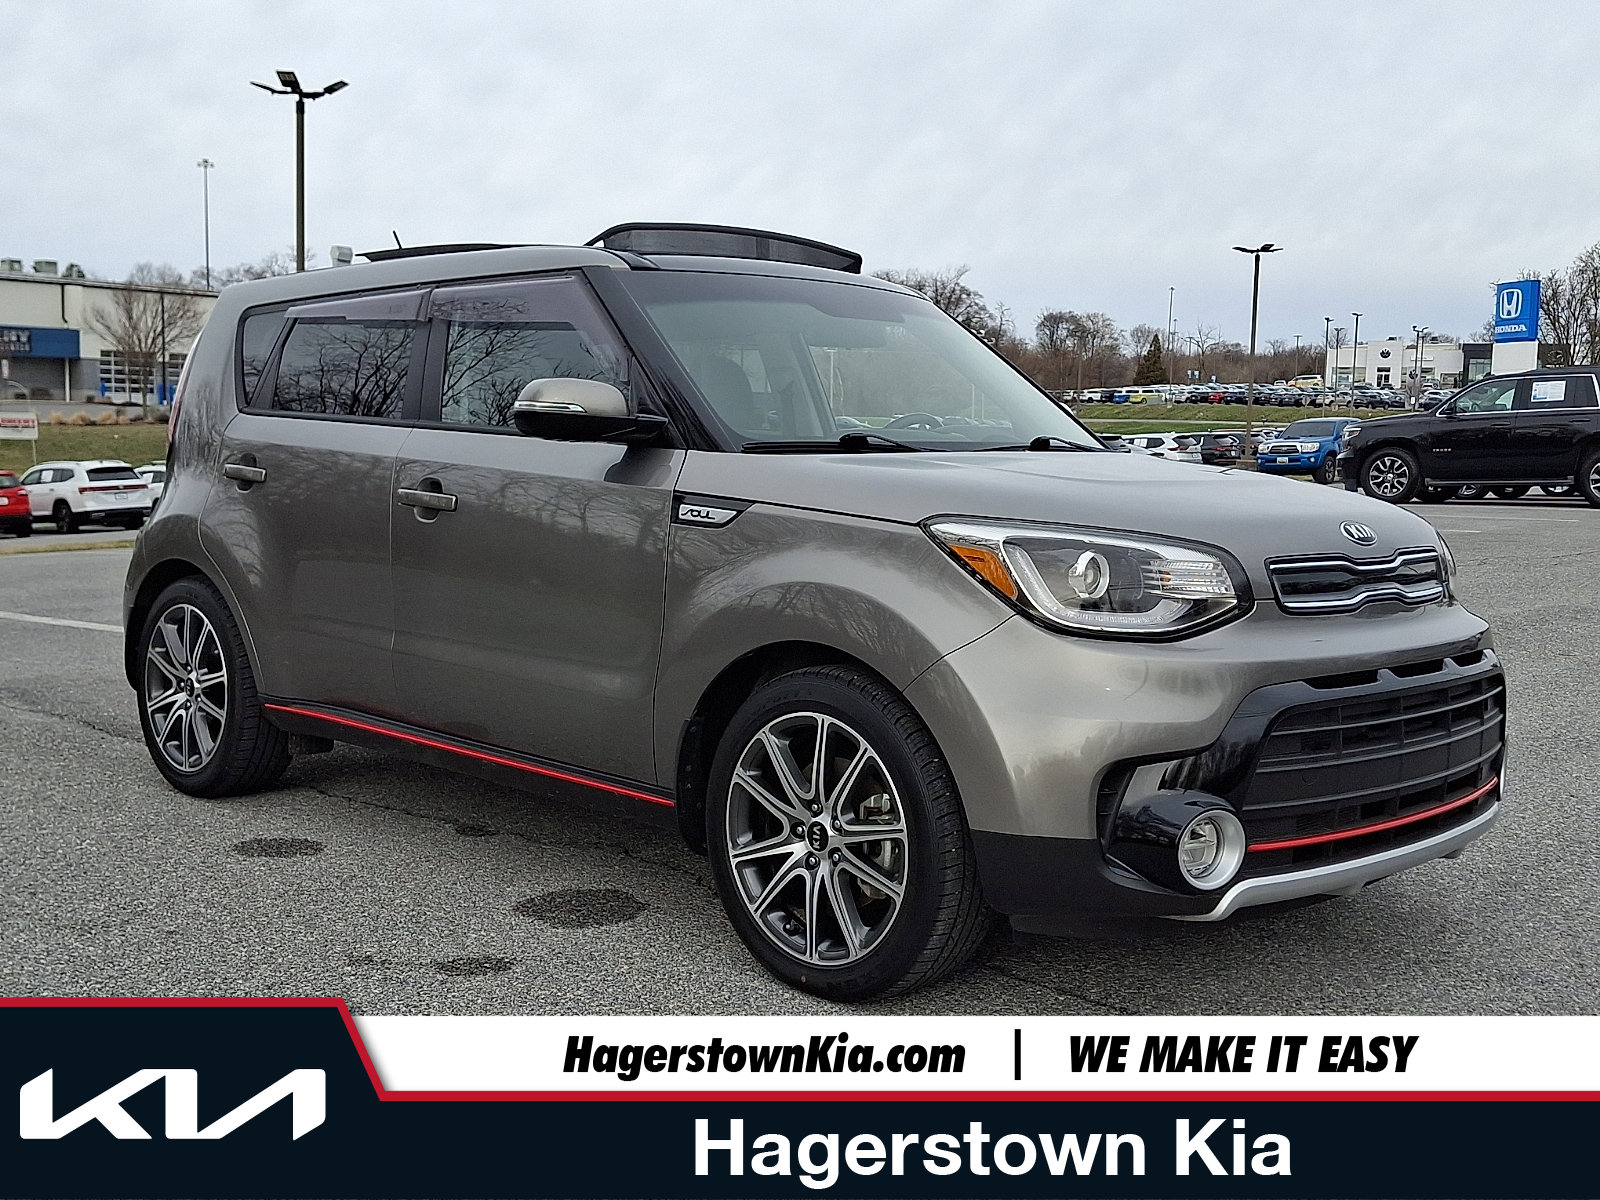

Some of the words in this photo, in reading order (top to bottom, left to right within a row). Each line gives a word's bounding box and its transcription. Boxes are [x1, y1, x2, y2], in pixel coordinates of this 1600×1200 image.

[1495, 324, 1527, 334] HONDA
[1345, 523, 1376, 539] KIA
[812, 825, 822, 850] KIA
